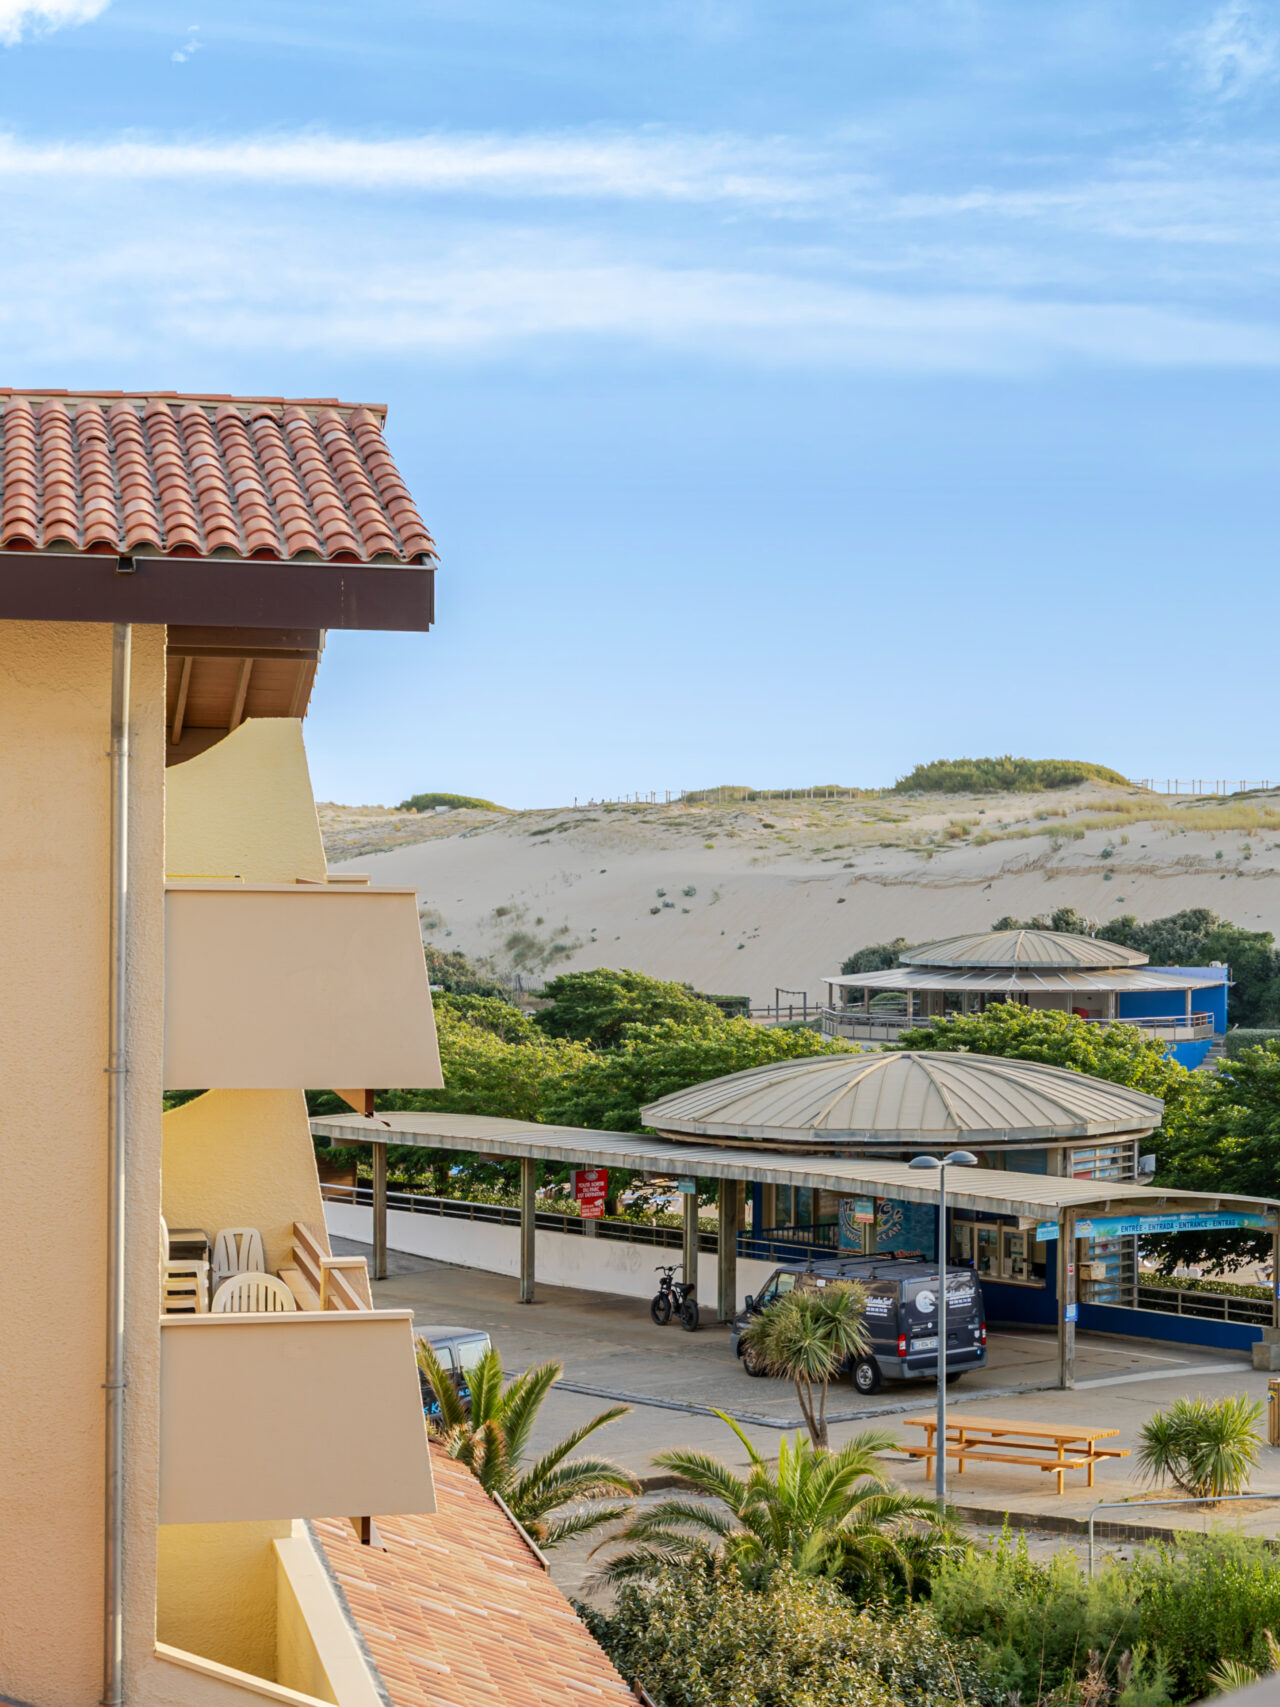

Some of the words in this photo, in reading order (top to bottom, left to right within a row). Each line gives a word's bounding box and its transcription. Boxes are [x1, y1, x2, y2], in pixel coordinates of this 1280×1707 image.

[1120, 1224, 1143, 1233] ENTRÉE
[1148, 1222, 1174, 1231] ENTRADA
[1178, 1220, 1208, 1229] ENTRANCE
